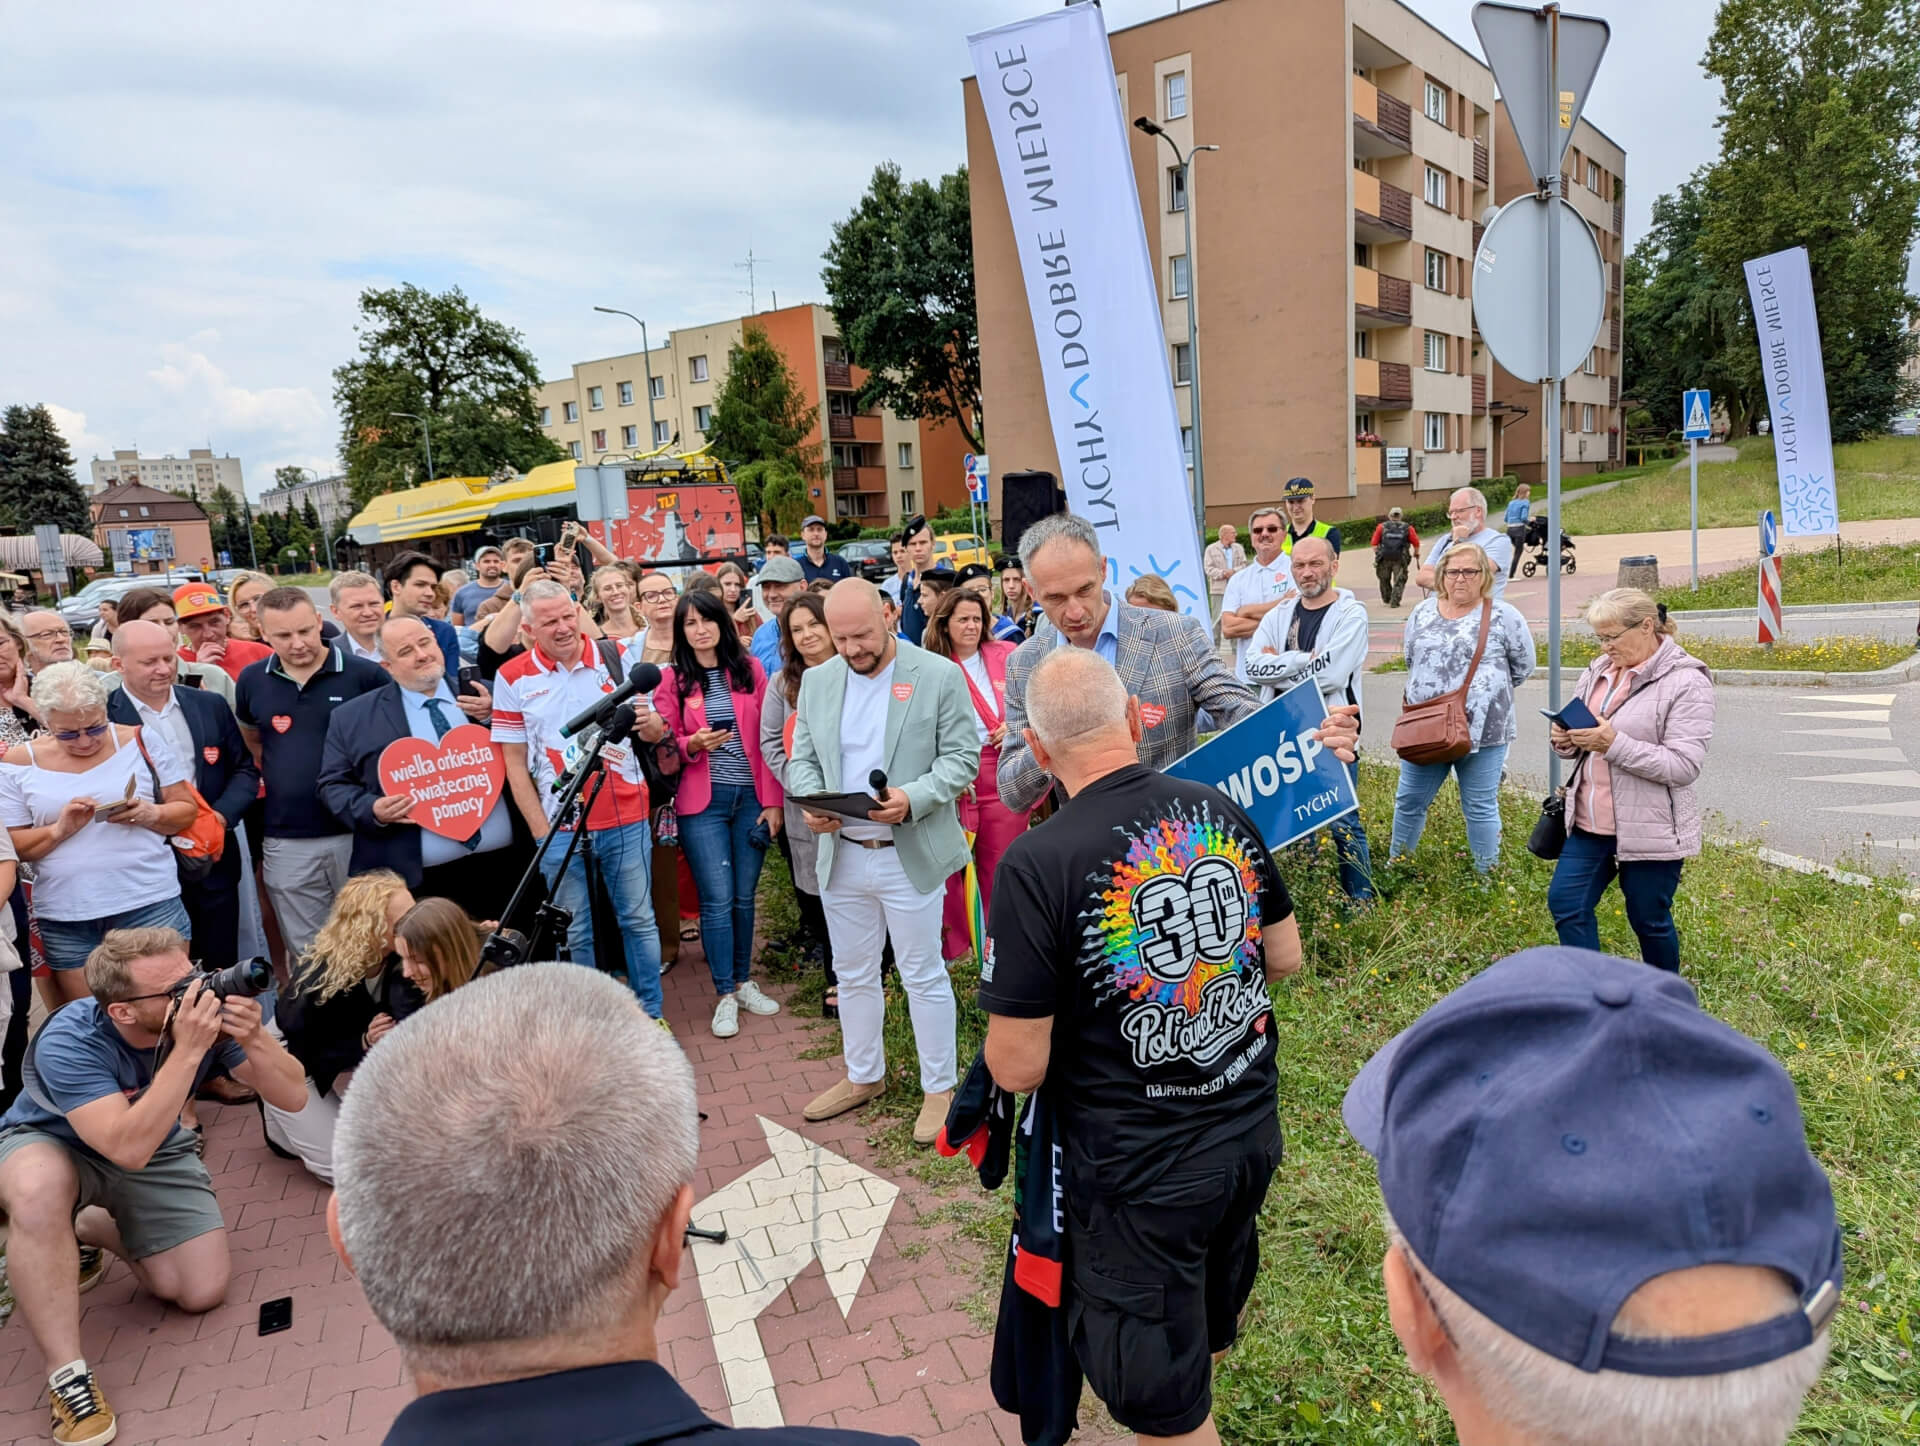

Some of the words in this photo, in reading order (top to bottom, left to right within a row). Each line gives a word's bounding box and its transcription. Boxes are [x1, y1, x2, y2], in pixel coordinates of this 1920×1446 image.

[657, 493, 678, 509] TLT
[390, 753, 436, 783] wielka
[437, 743, 494, 771] orkiestra
[1216, 727, 1324, 809] WOŚP
[409, 767, 493, 804] świątecznej
[1294, 786, 1340, 821] TYCHY
[431, 797, 484, 827] pomocy
